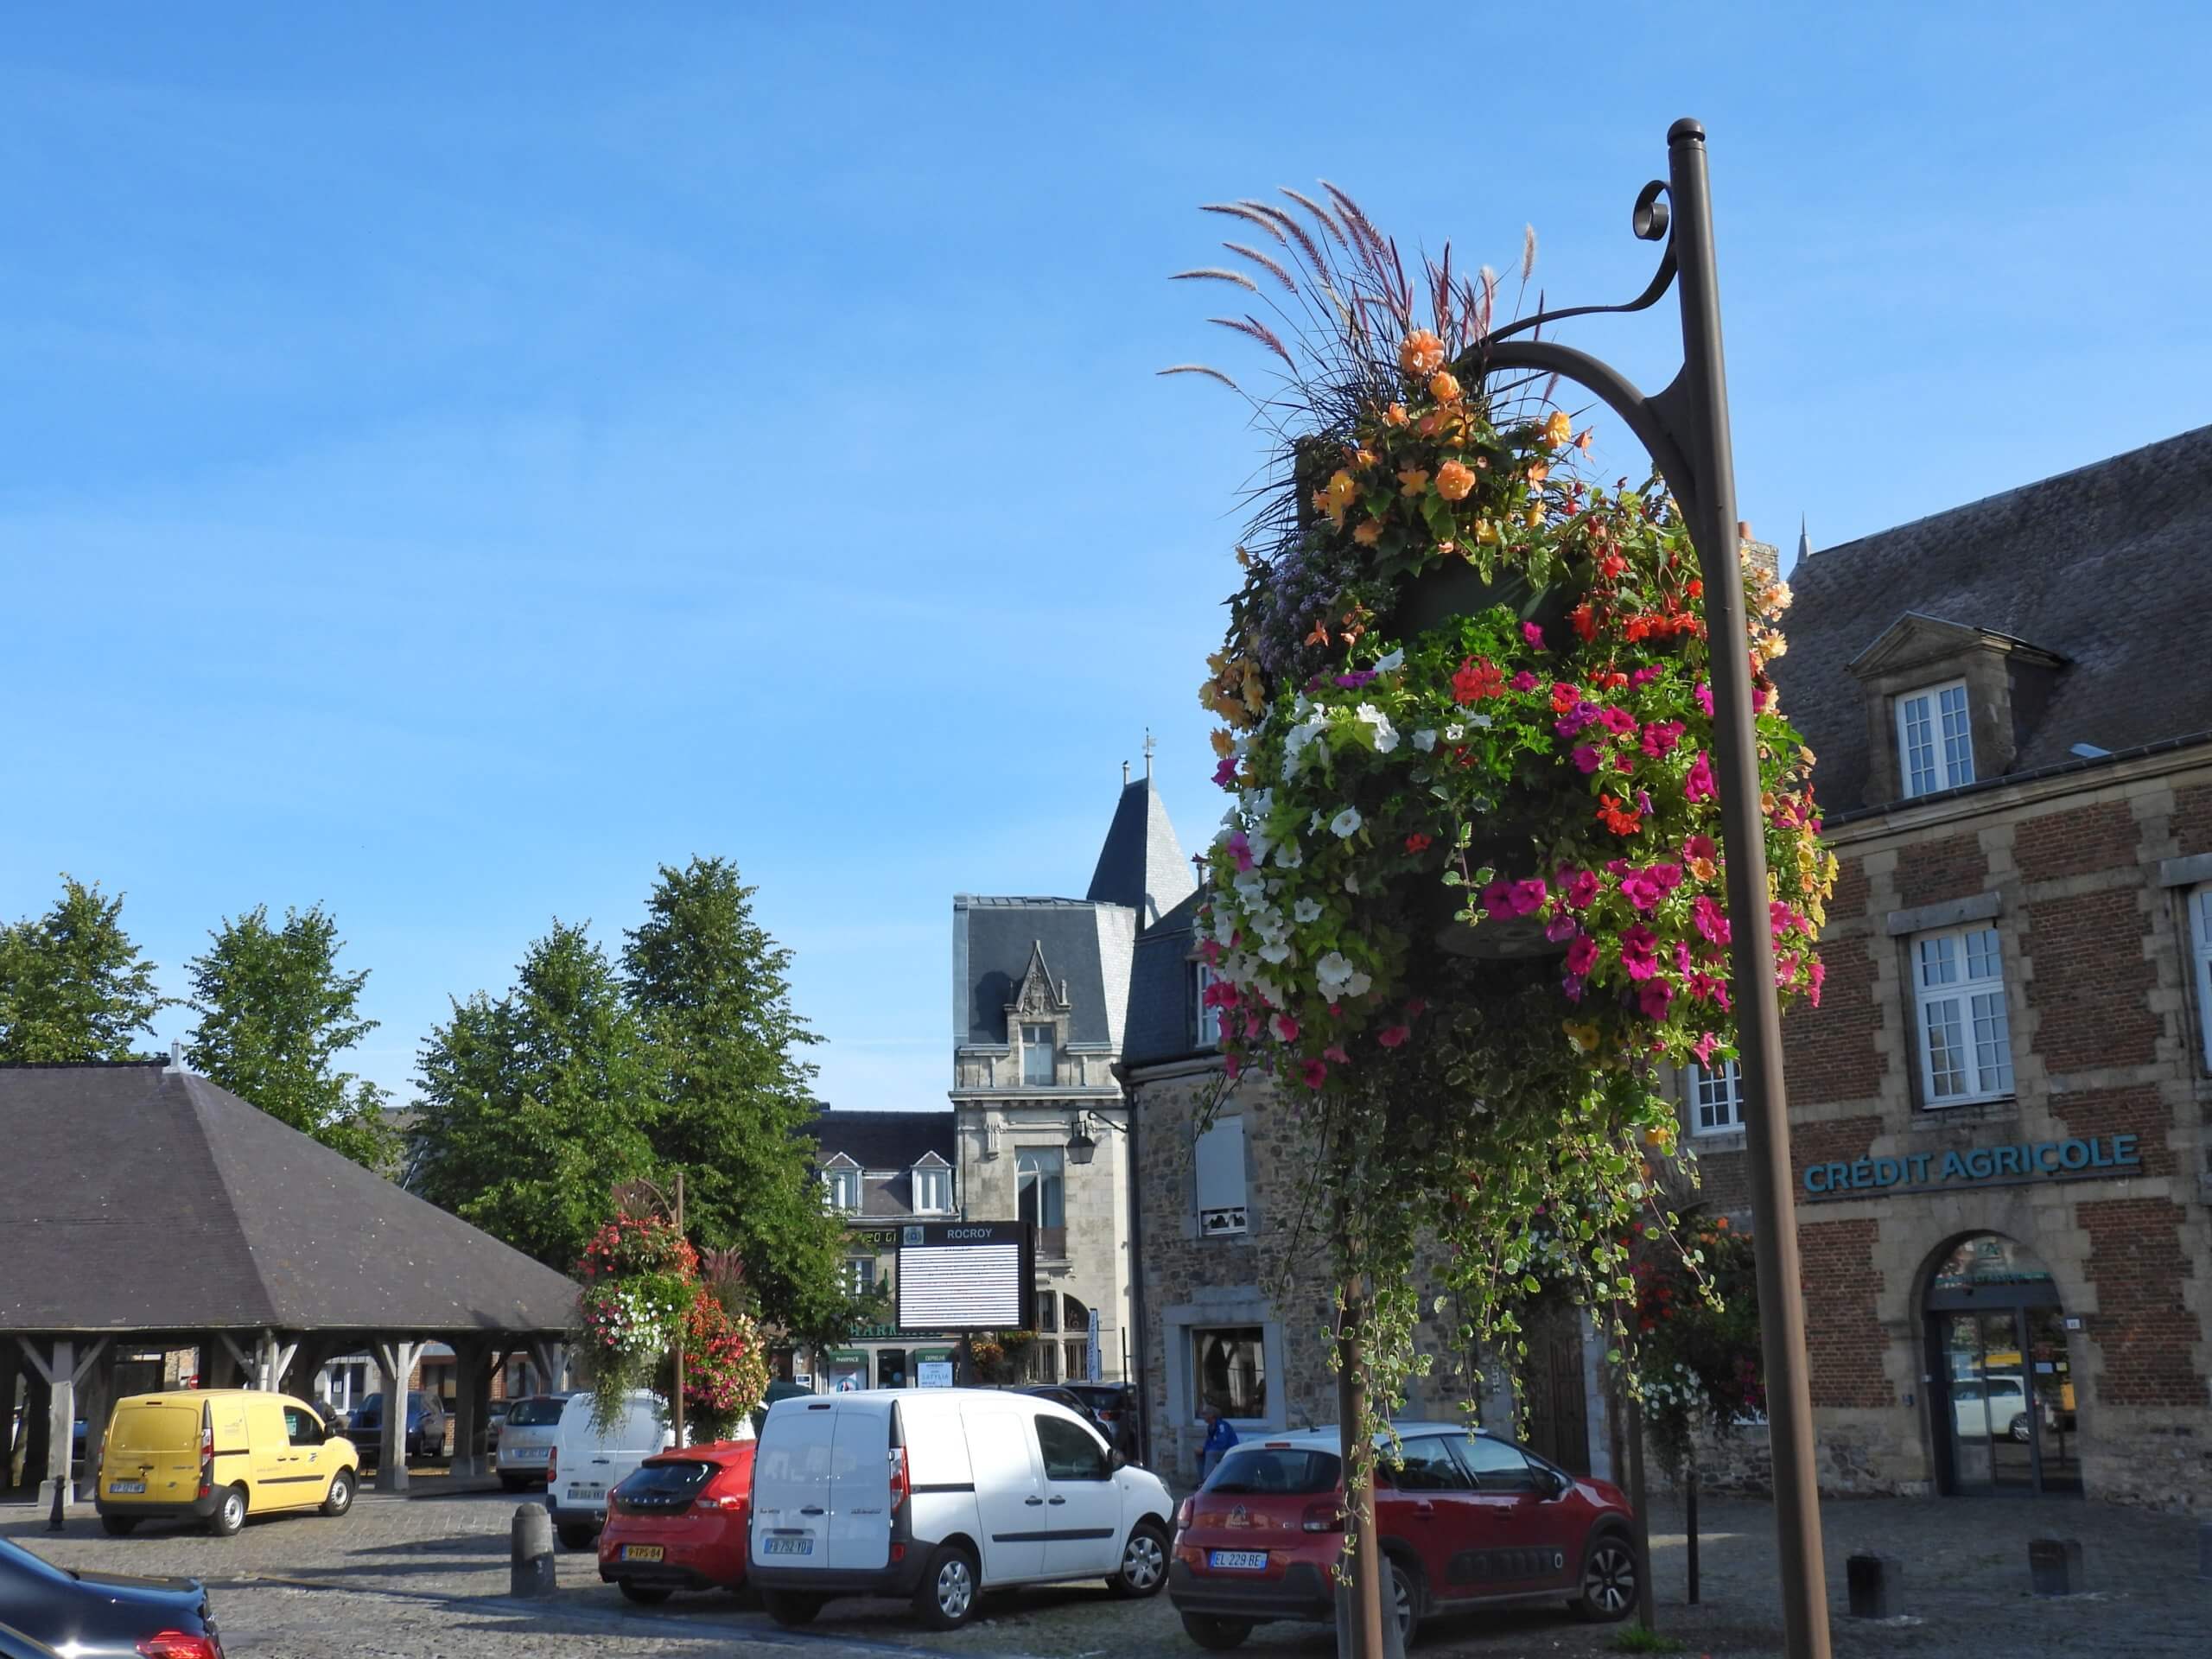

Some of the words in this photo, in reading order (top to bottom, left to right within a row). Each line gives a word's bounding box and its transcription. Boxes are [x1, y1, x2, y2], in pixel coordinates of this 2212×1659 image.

[1803, 1154, 1933, 1192] CRÉDIT
[1939, 1134, 2141, 1180] AGRICOLE
[947, 1228, 993, 1239] ROCROY
